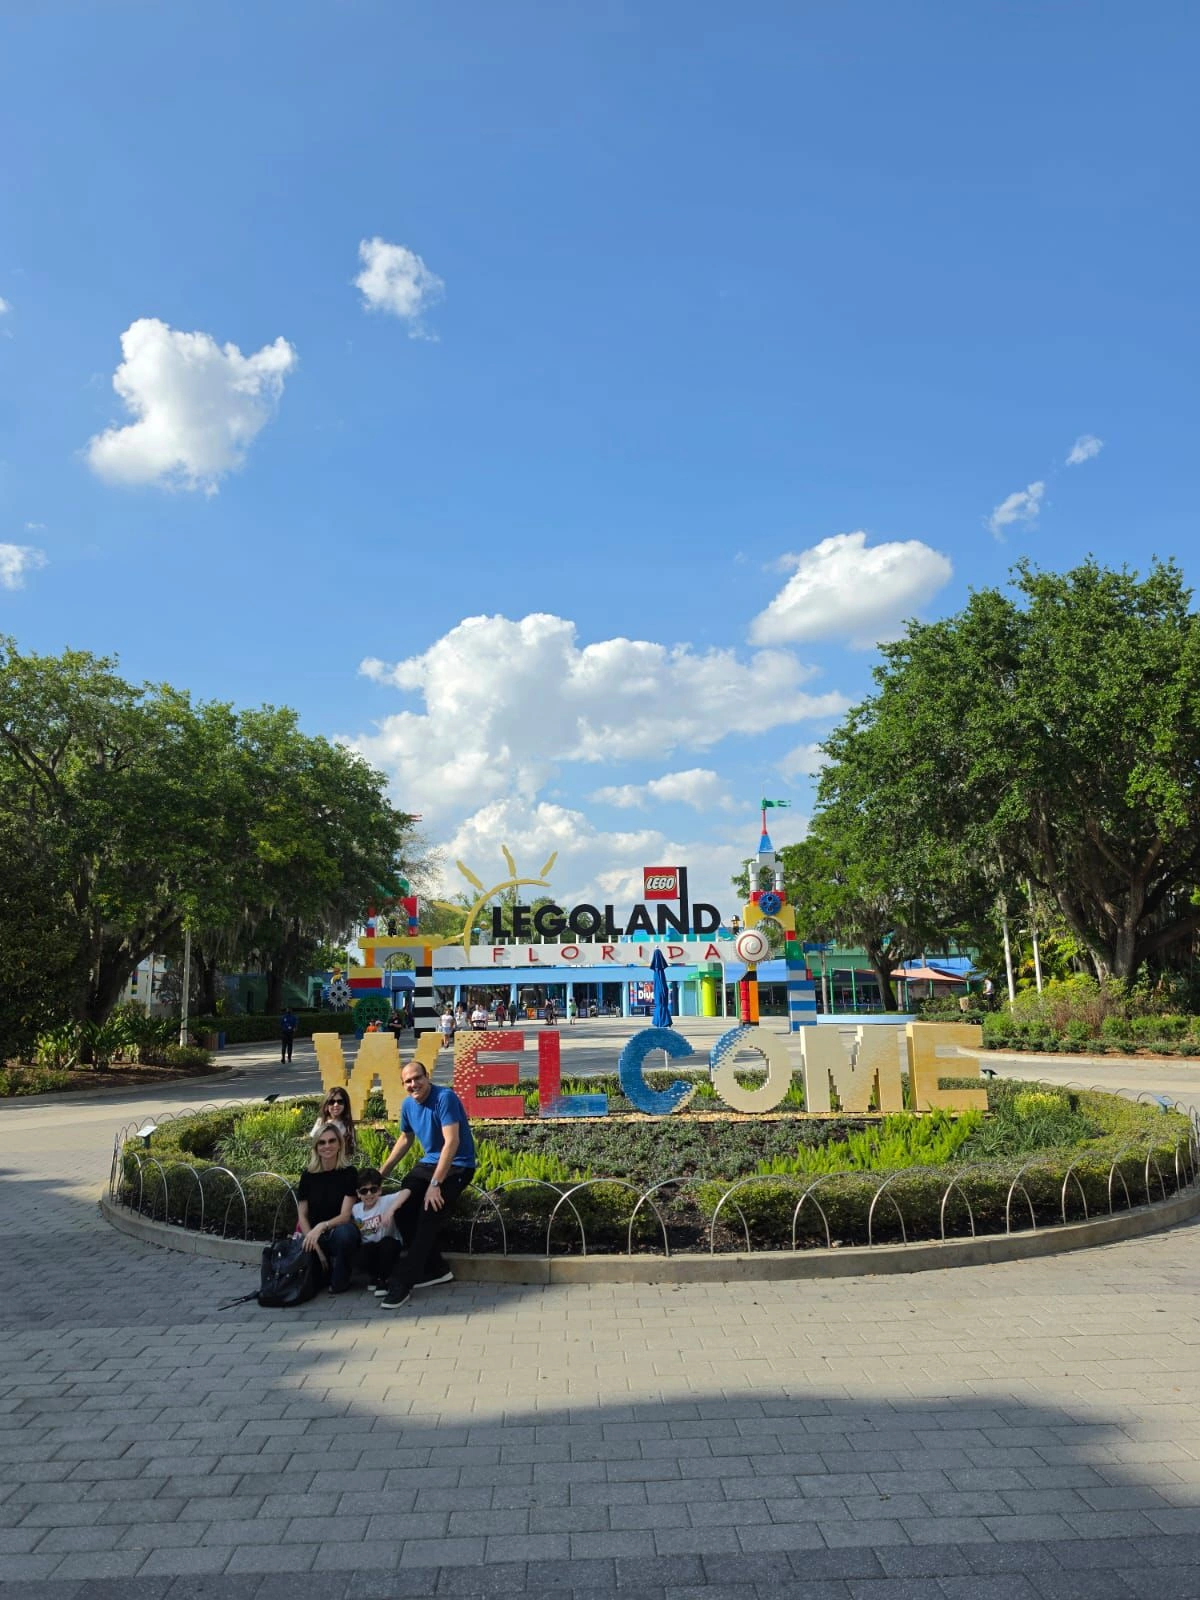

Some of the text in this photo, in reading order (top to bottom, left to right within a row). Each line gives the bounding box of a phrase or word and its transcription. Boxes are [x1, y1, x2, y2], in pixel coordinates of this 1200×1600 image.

[646, 877, 675, 890] LEGO
[492, 902, 721, 937] LEGOLAND
[492, 944, 721, 962] FLORIDA
[312, 1023, 989, 1121] WELCOME
